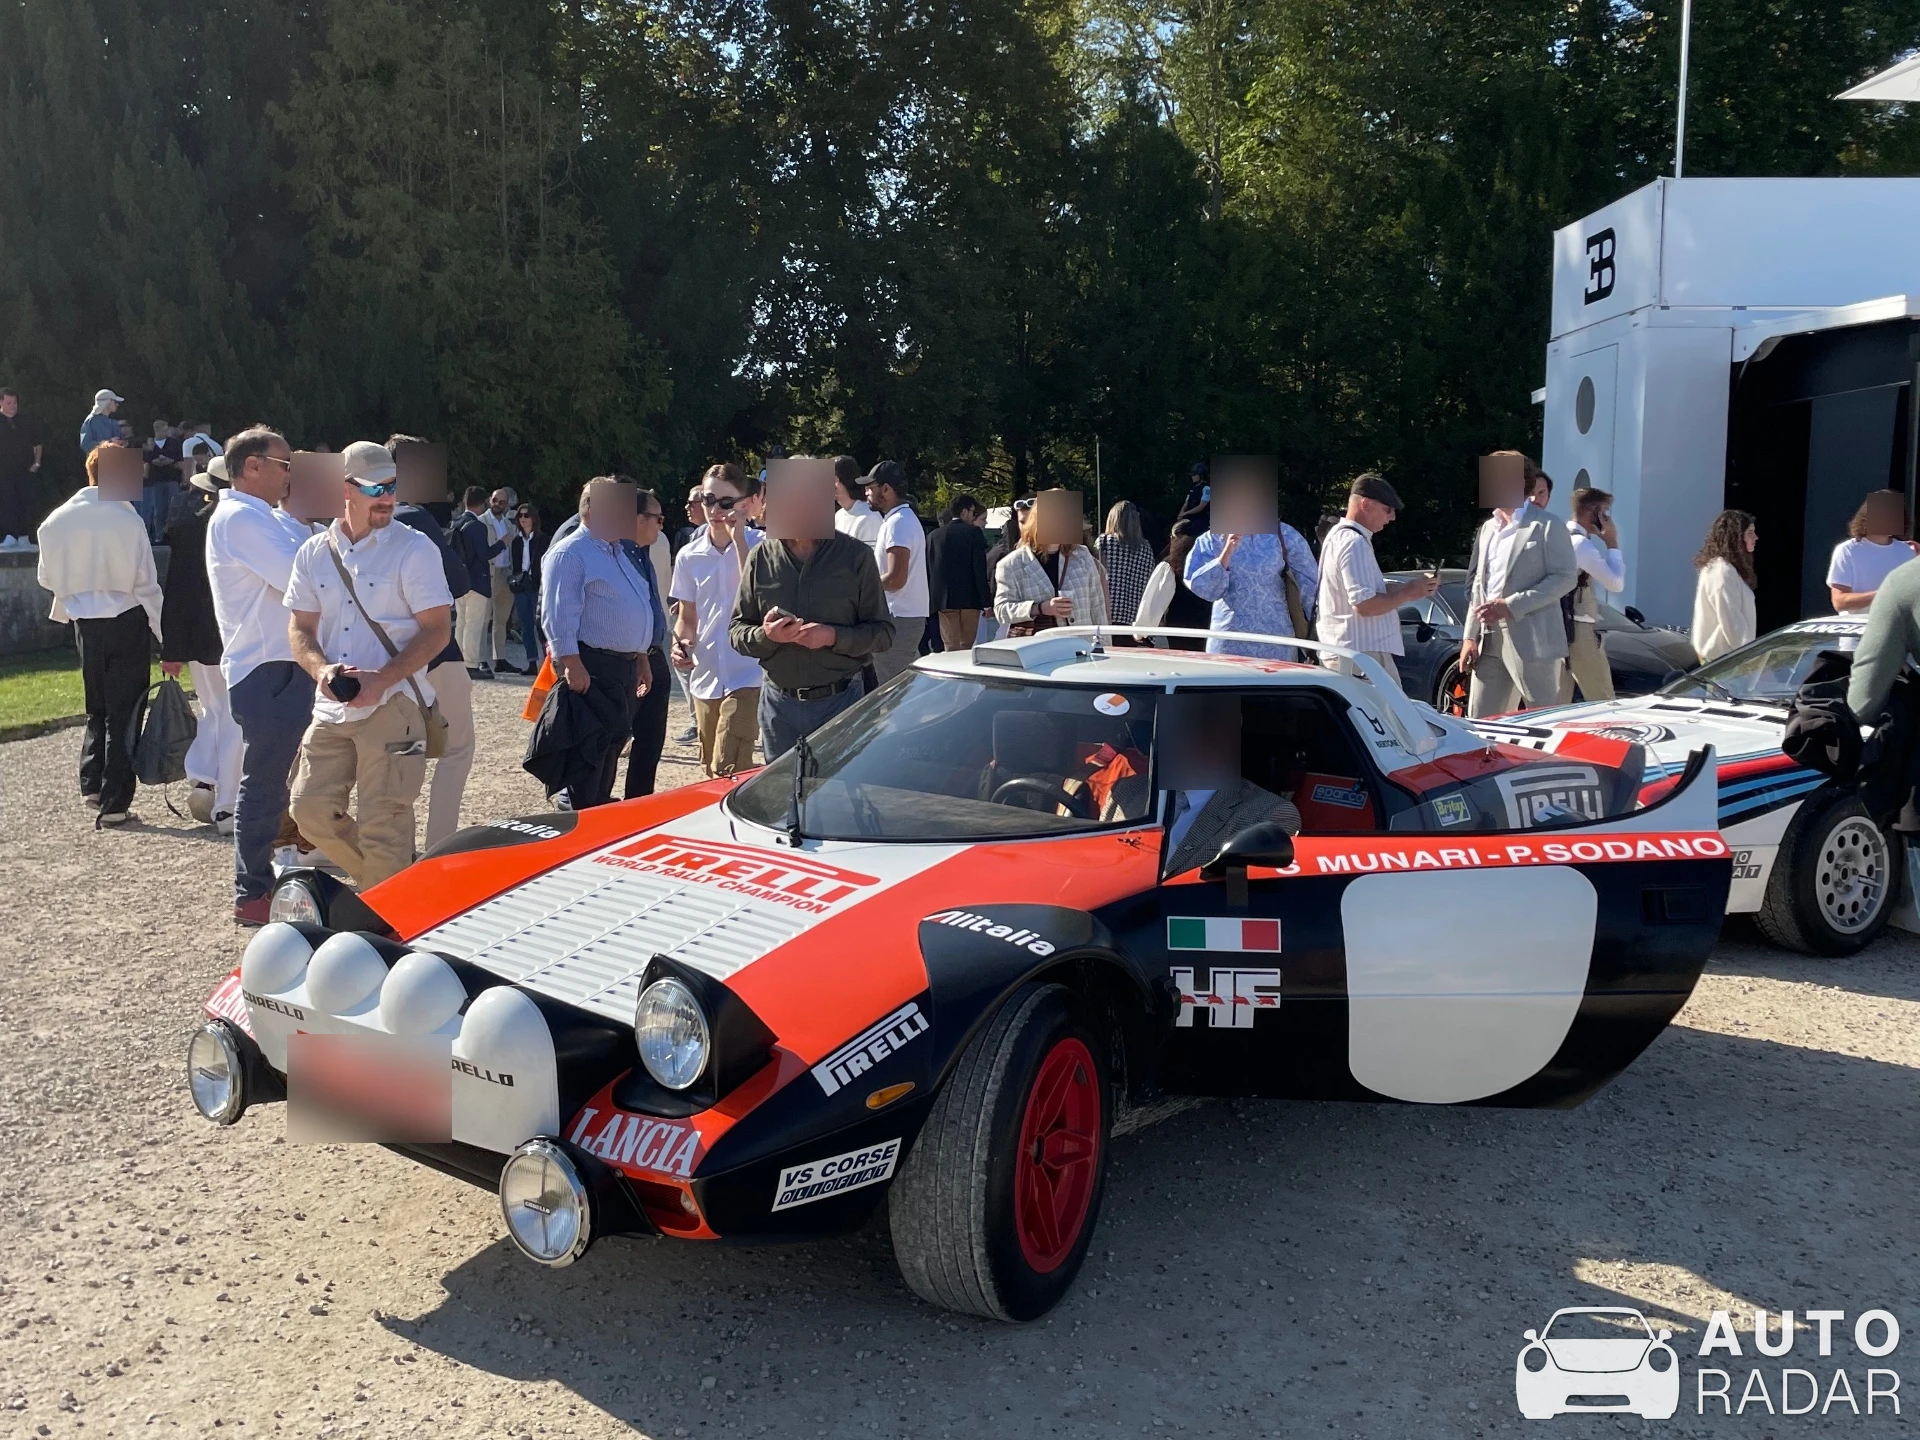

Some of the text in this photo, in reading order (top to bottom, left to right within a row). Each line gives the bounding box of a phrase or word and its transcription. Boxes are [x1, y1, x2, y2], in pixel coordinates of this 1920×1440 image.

[1494, 765, 1605, 829] PIRELLI
[591, 854, 832, 915] WORLD RALLY CHAMPION
[608, 833, 881, 904] PIRELLI
[1316, 848, 1482, 873] MUNARI
[921, 910, 1057, 957] Alitalia
[242, 988, 305, 1021] CARELLO
[810, 1001, 931, 1098] PIRELLI
[569, 1107, 702, 1177] LANCIA
[784, 1143, 898, 1188] VS CORSE
